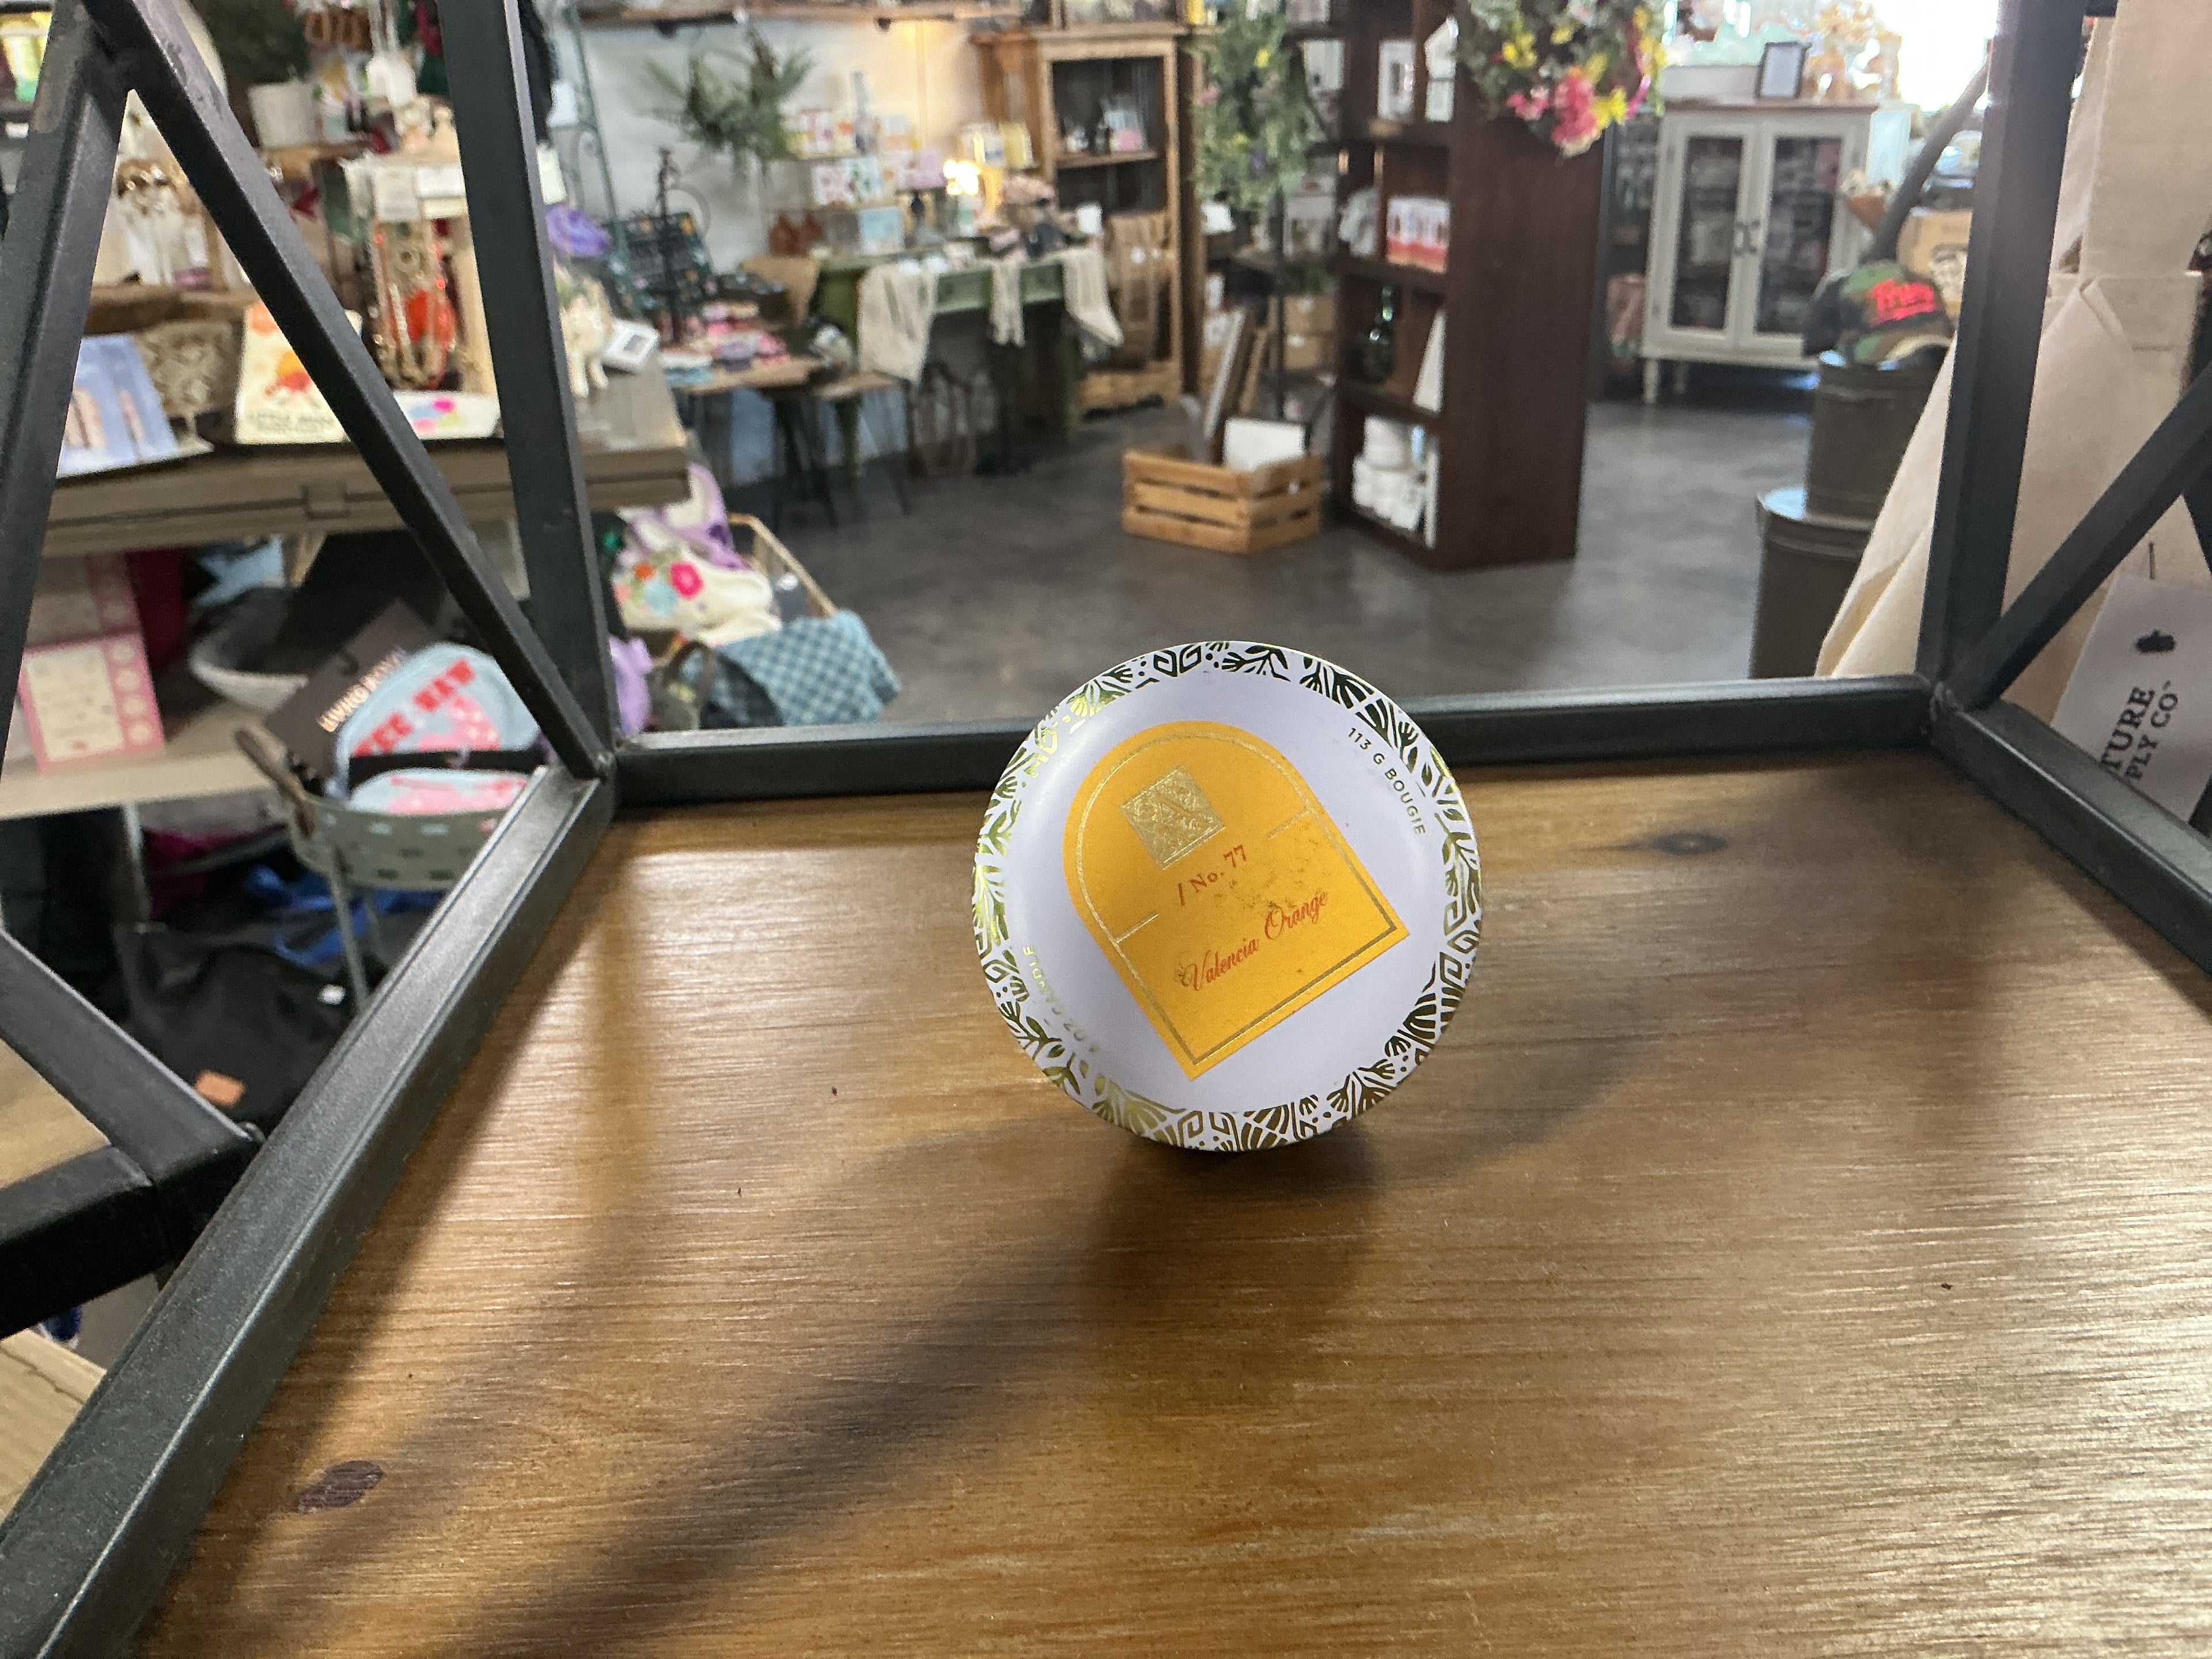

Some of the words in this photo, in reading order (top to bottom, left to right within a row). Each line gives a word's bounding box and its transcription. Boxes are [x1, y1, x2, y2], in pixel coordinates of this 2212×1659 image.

[2101, 685, 2155, 771] TURE
[1348, 728, 1373, 751] 113
[1373, 752, 1385, 765] G
[1384, 768, 1427, 835] BOUGIE
[1189, 872, 1225, 893] No.
[1223, 844, 1247, 868] 77
[1178, 938, 1259, 991] Valencia
[1264, 891, 1327, 940] Orange
